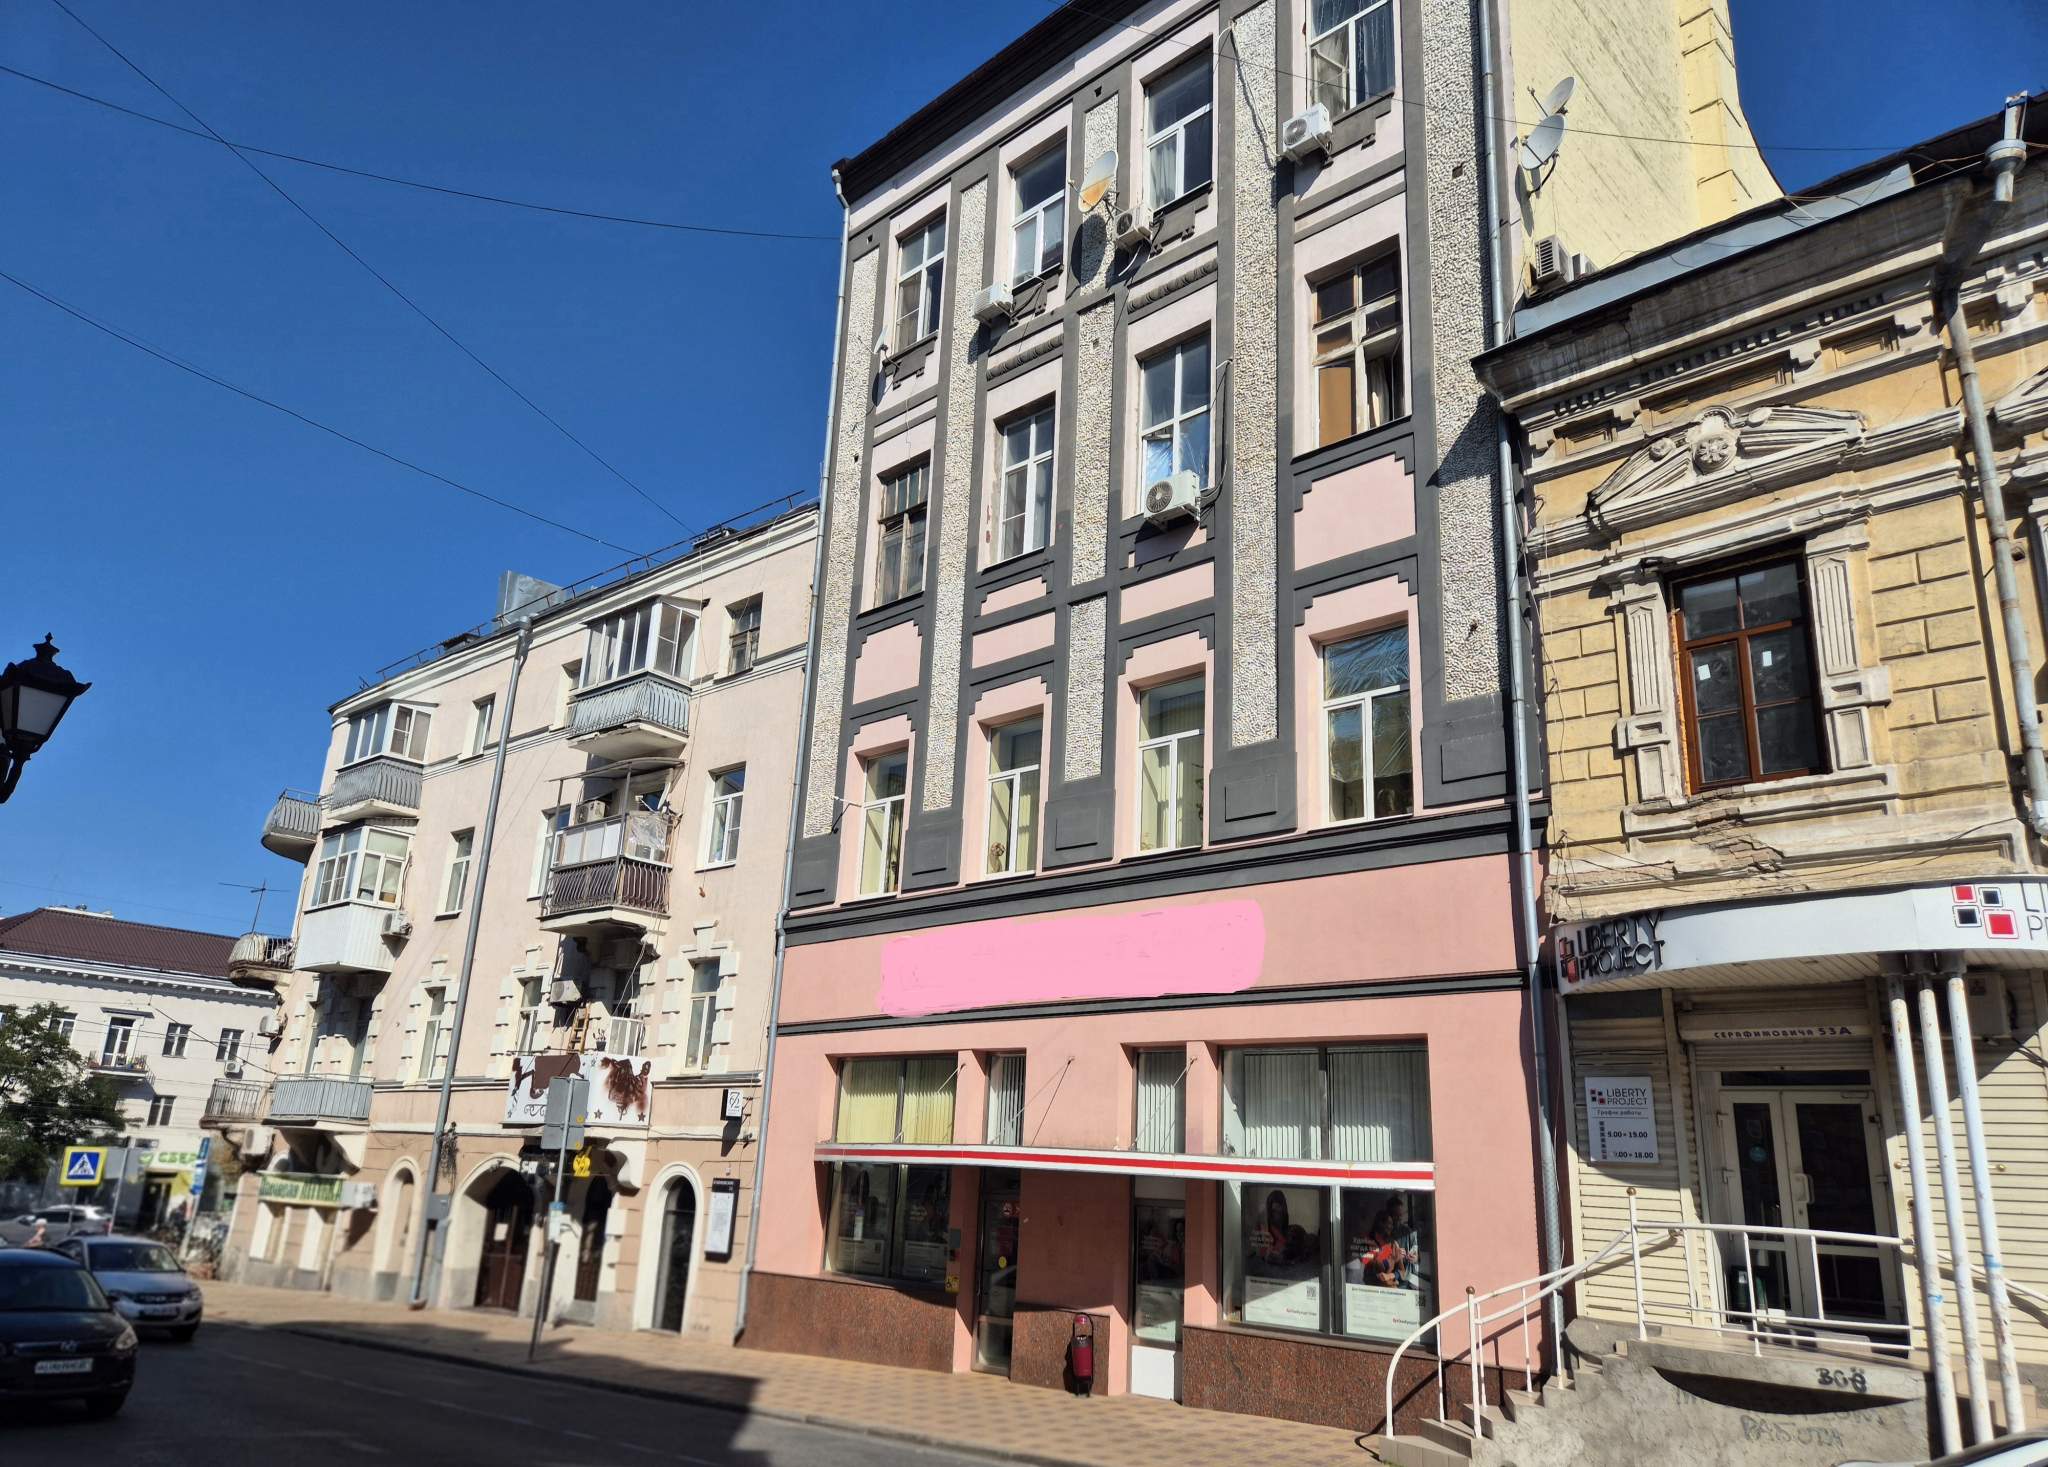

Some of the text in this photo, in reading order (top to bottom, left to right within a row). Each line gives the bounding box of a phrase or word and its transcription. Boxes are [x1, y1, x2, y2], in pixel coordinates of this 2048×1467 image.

[2019, 880, 2048, 913] LI
[1577, 911, 1663, 956] LIBERTY
[1579, 940, 1665, 979] PROJECT
[1606, 1088, 1647, 1098] LIBERTY
[1607, 1097, 1648, 1105] PROJECT
